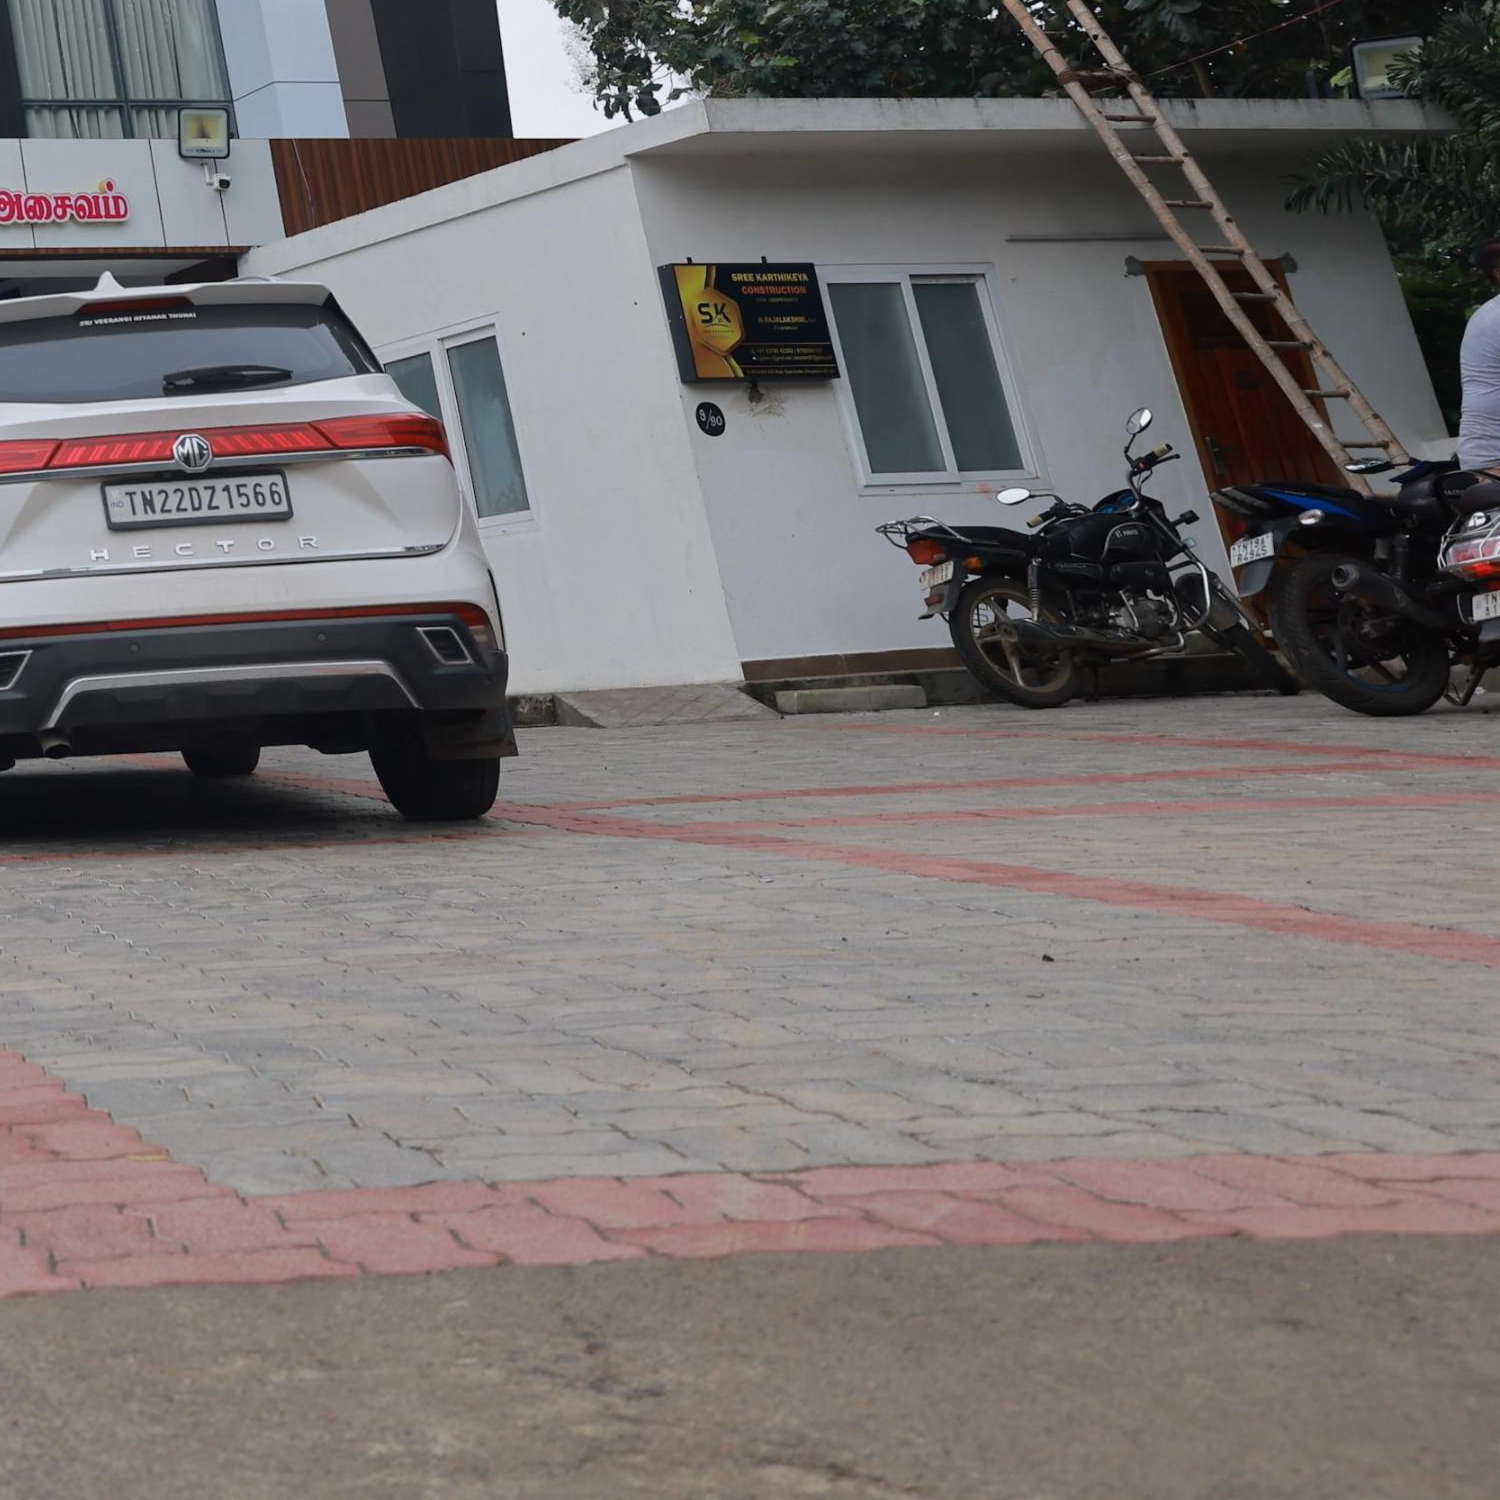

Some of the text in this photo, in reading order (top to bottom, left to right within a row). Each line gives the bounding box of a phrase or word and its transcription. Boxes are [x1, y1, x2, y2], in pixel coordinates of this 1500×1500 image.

[731, 272, 809, 282] SREE KARTHIKEYA
[741, 286, 808, 295] CONSTRUCTION
[124, 481, 284, 517] TN22DZ1566
[89, 535, 319, 562] HECTOR
